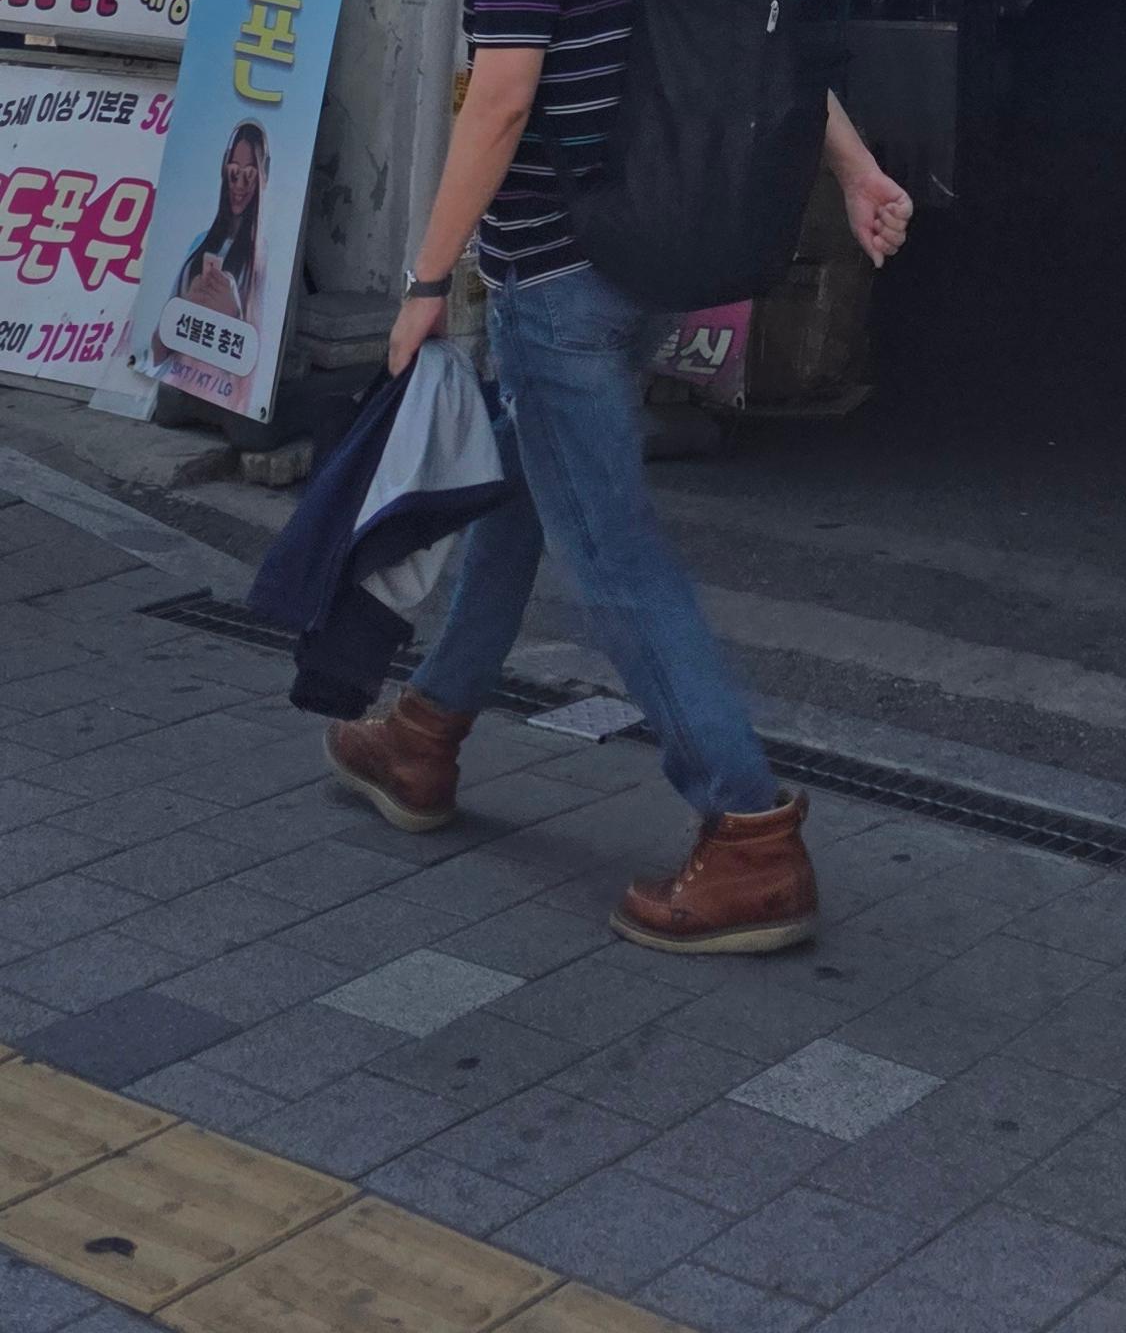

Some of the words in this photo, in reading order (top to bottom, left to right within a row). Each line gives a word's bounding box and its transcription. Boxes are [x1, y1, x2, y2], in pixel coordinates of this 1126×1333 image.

[0, 94, 38, 127] 5세
[36, 90, 81, 123] 이상
[78, 90, 139, 125] 기본료
[0, 166, 98, 284] 도폰
[26, 321, 115, 363] 기기값
[176, 313, 217, 349] 선불폰
[217, 327, 245, 360] 충전
[217, 381, 233, 398] LG
